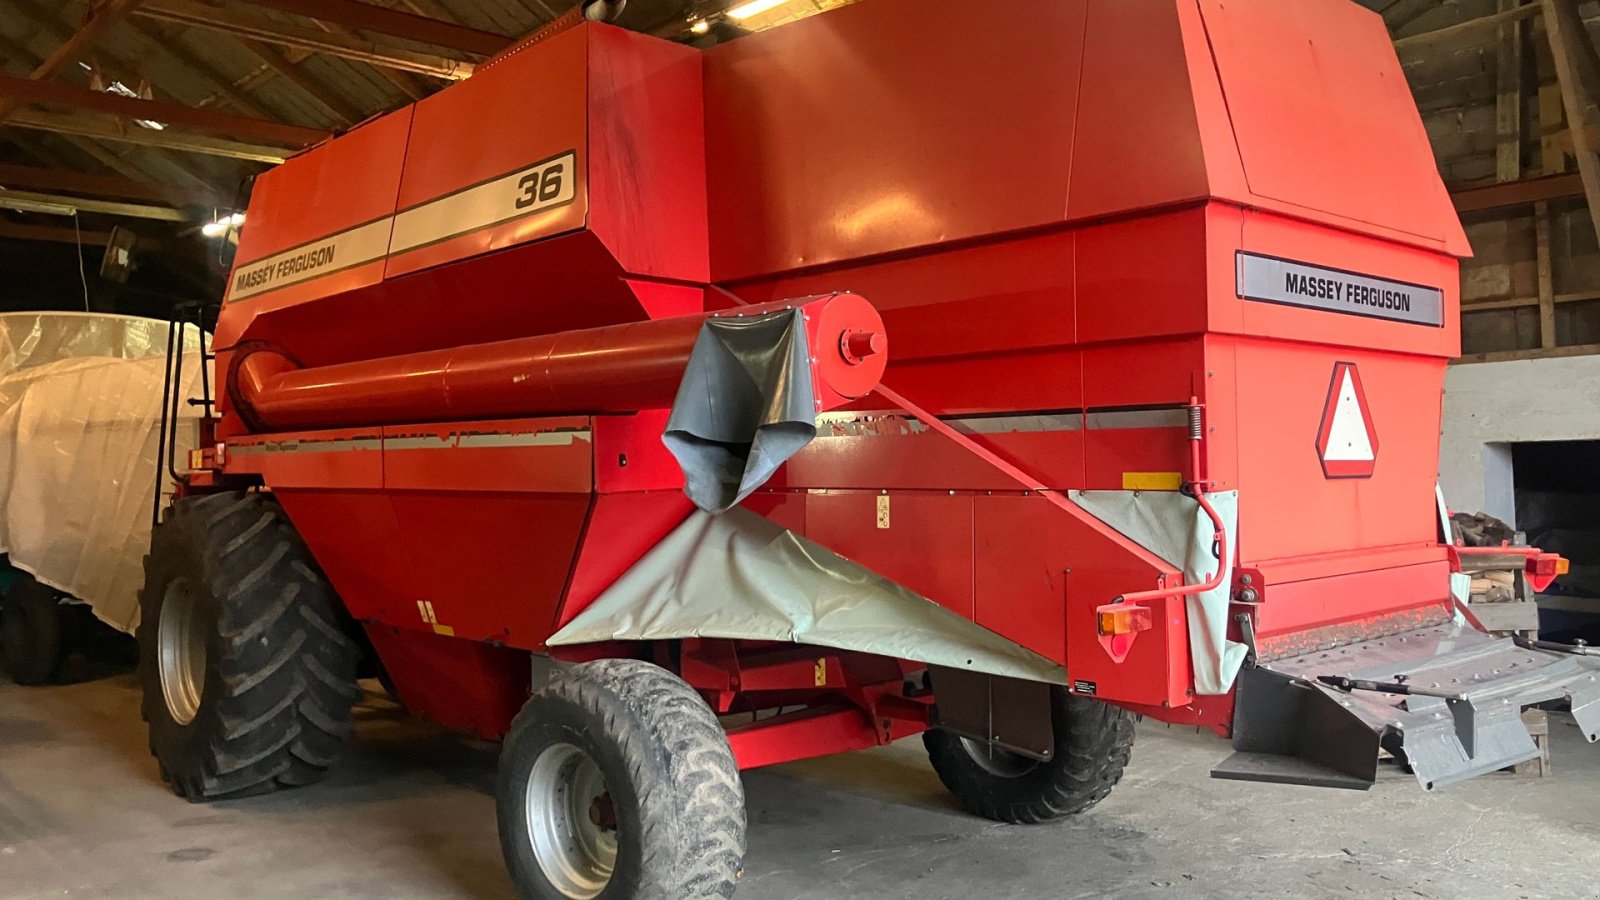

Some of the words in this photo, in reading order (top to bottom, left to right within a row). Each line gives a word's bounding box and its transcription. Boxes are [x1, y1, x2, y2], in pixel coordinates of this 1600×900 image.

[515, 163, 564, 210] 36
[235, 263, 277, 292] MASSEY
[276, 244, 336, 280] FERGUSON
[1285, 272, 1343, 301] MASSEY
[1345, 283, 1411, 312] FERGUSON
